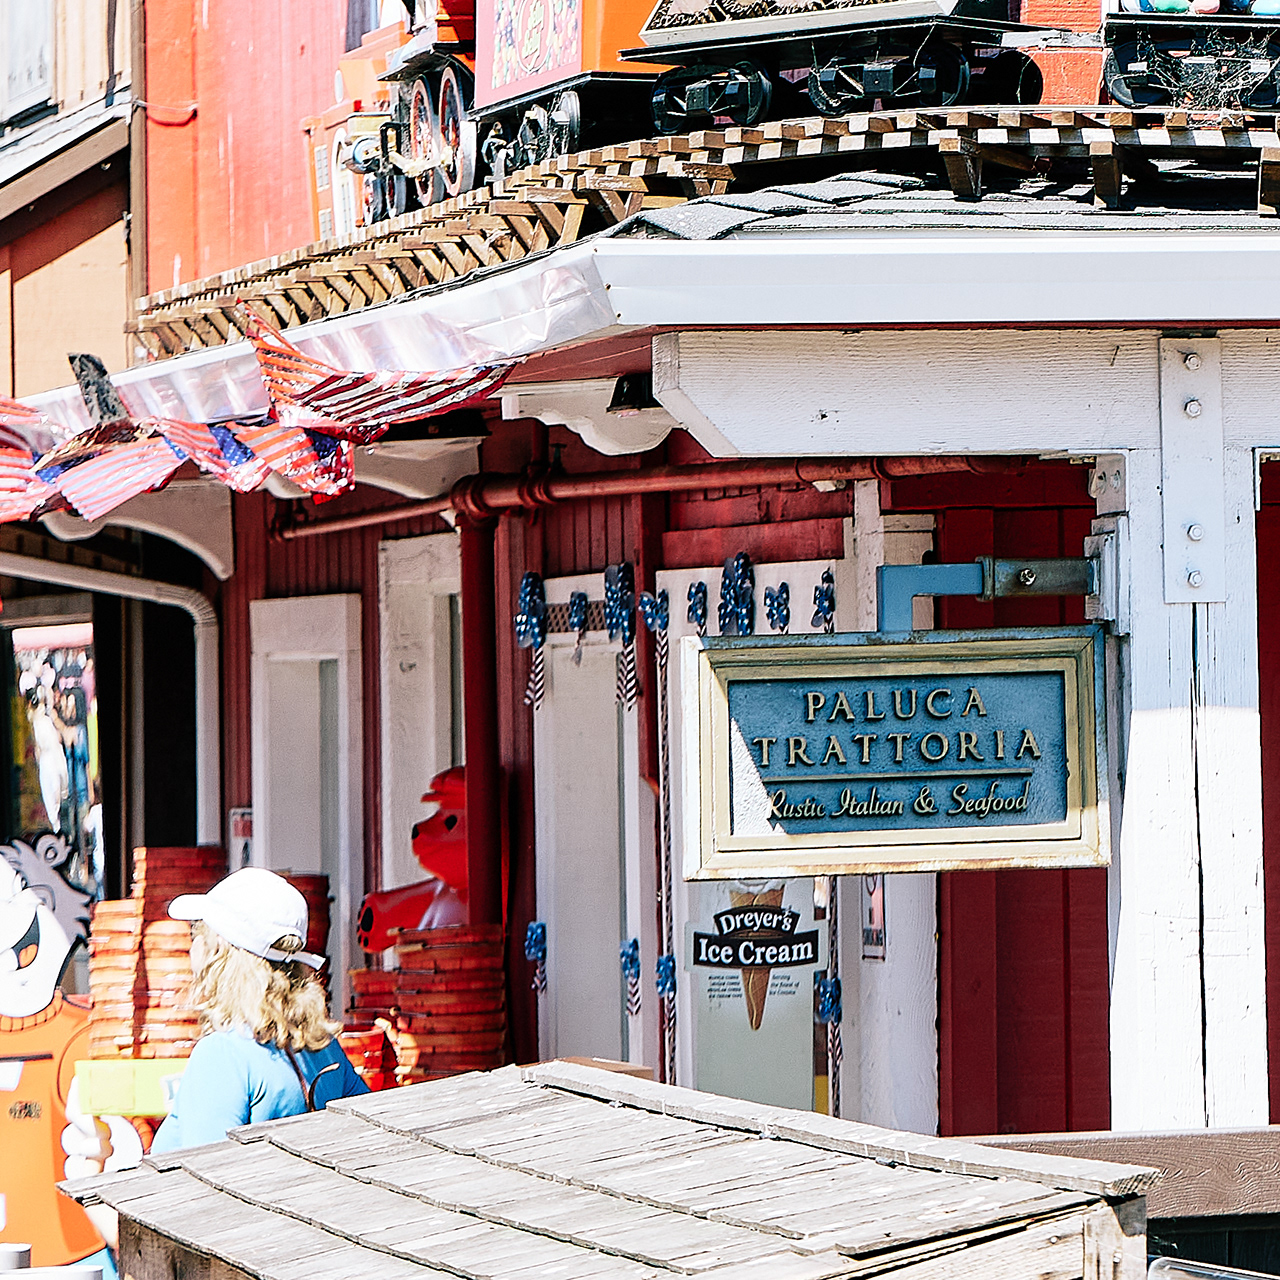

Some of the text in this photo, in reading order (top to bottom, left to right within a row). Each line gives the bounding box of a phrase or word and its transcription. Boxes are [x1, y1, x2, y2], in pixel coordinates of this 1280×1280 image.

[803, 686, 989, 723] PALUCA
[751, 728, 1042, 768] TRATTORIA
[766, 780, 1031, 820] Rustic Italian & Seafood
[719, 910, 793, 936] Dreyer's
[698, 937, 813, 965] Ice Cream
